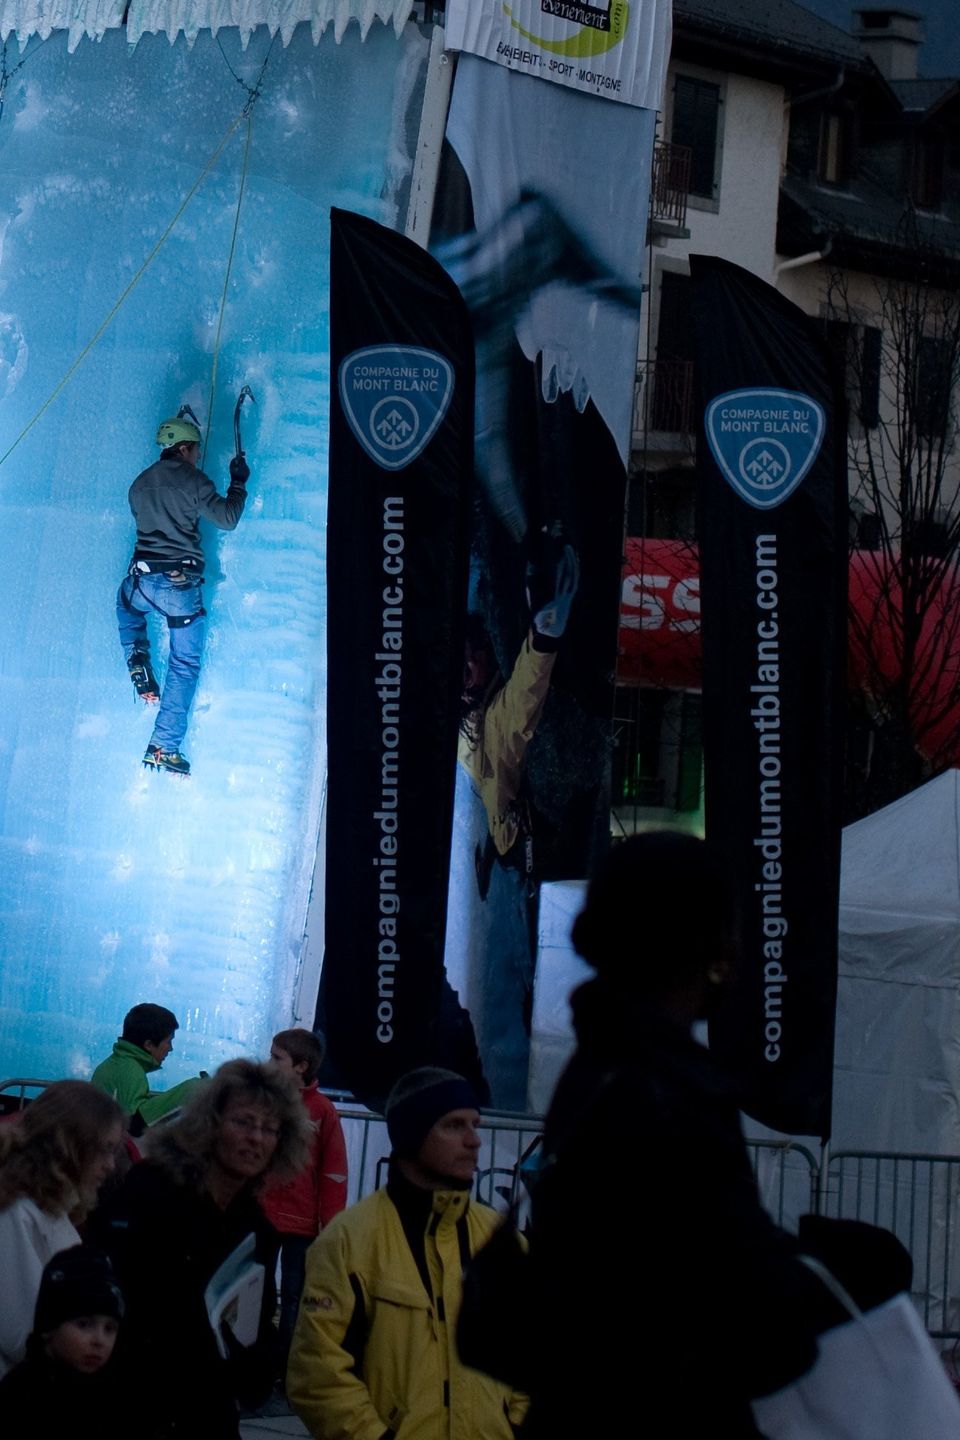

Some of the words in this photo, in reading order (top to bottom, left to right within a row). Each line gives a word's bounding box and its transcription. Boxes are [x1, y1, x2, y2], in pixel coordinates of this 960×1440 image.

[548, 59, 574, 76] SPORT
[578, 69, 622, 92] MONTAGNE
[353, 366, 419, 378] COMPAGNIE
[423, 368, 439, 378] DU
[353, 378, 391, 391] MONT
[394, 379, 439, 392] BLANC
[721, 408, 790, 420] COMPAGNIE
[793, 410, 810, 421] DU
[721, 421, 760, 433] MONT
[764, 422, 809, 434] BLANC
[373, 496, 406, 1044] compagniedumontblanc.com
[750, 534, 789, 1062] compagniedumontblanc.com
